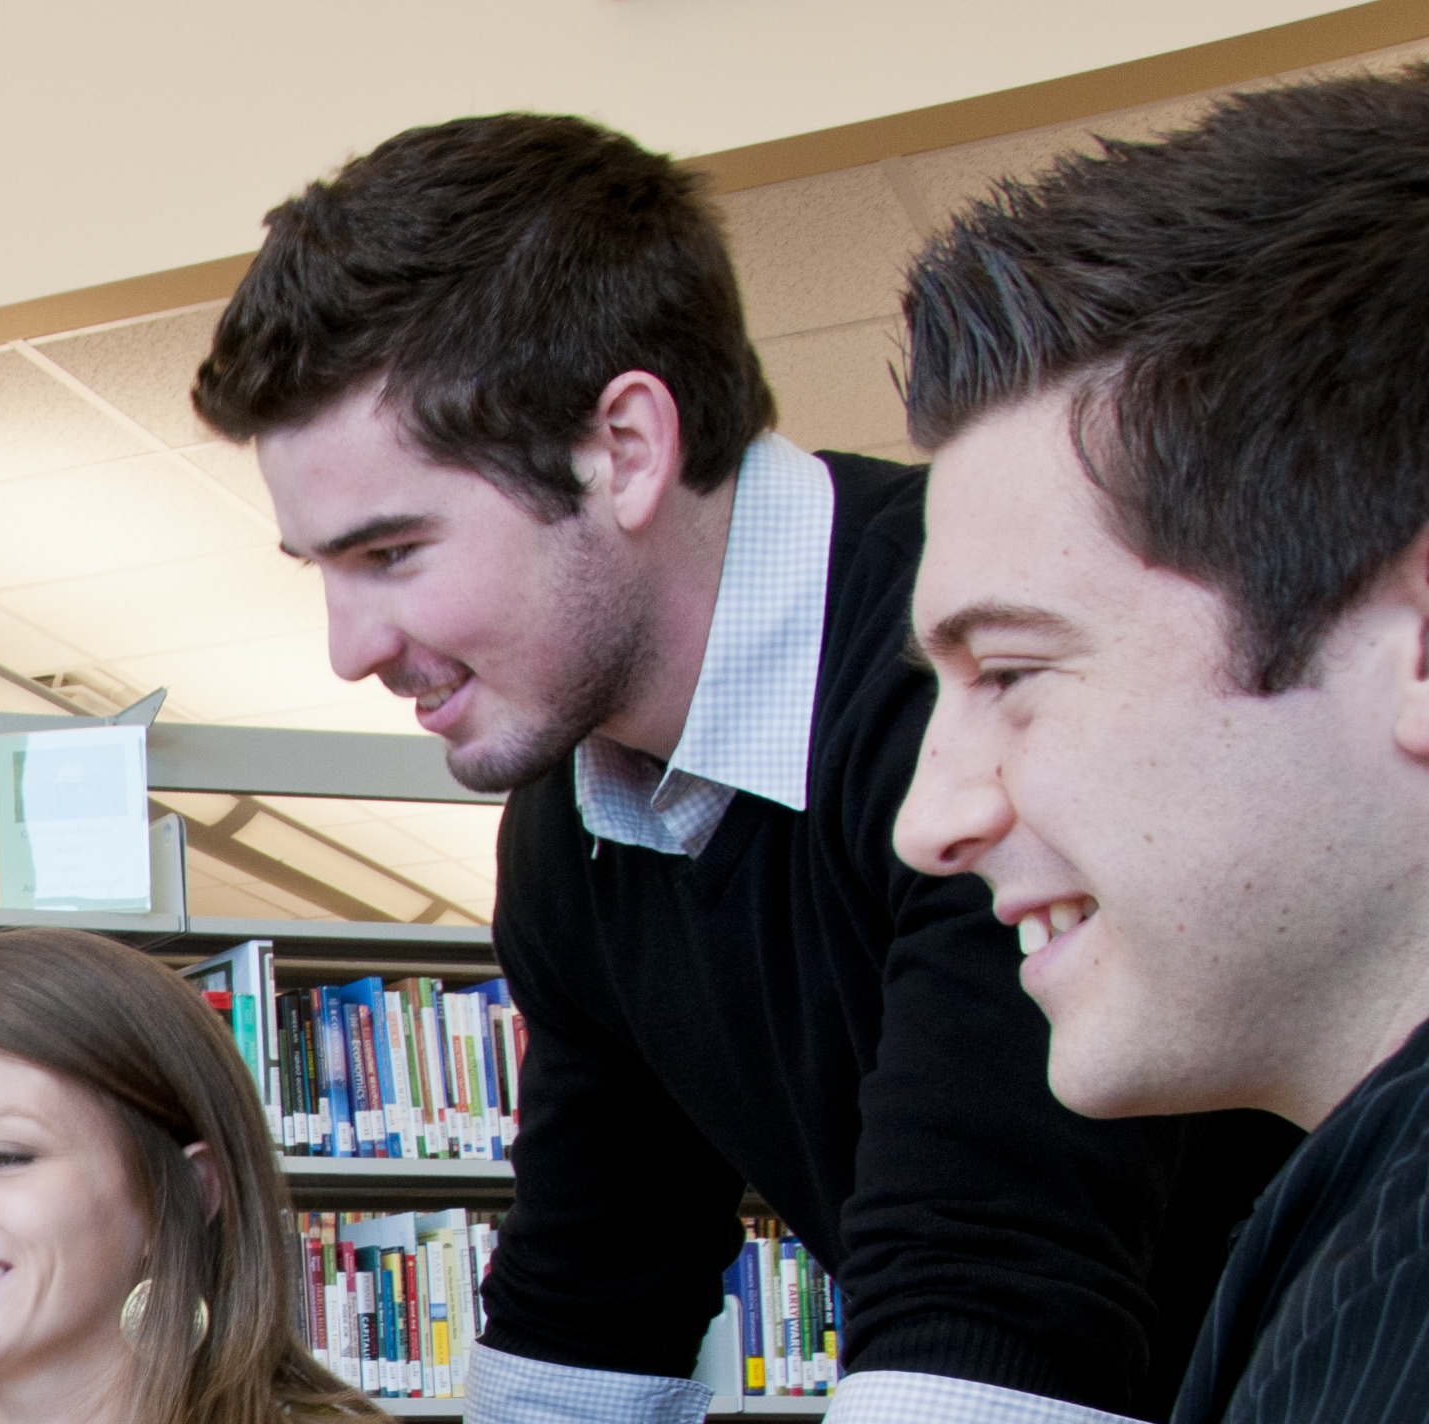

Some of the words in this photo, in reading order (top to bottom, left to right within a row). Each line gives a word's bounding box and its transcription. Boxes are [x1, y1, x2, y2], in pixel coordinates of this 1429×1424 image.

[330, 1010, 342, 1071] ECONOMICS
[294, 1051, 302, 1075] naked
[351, 1039, 365, 1100] Economics
[364, 1275, 372, 1310] POSNER
[788, 1283, 799, 1317] EARLY
